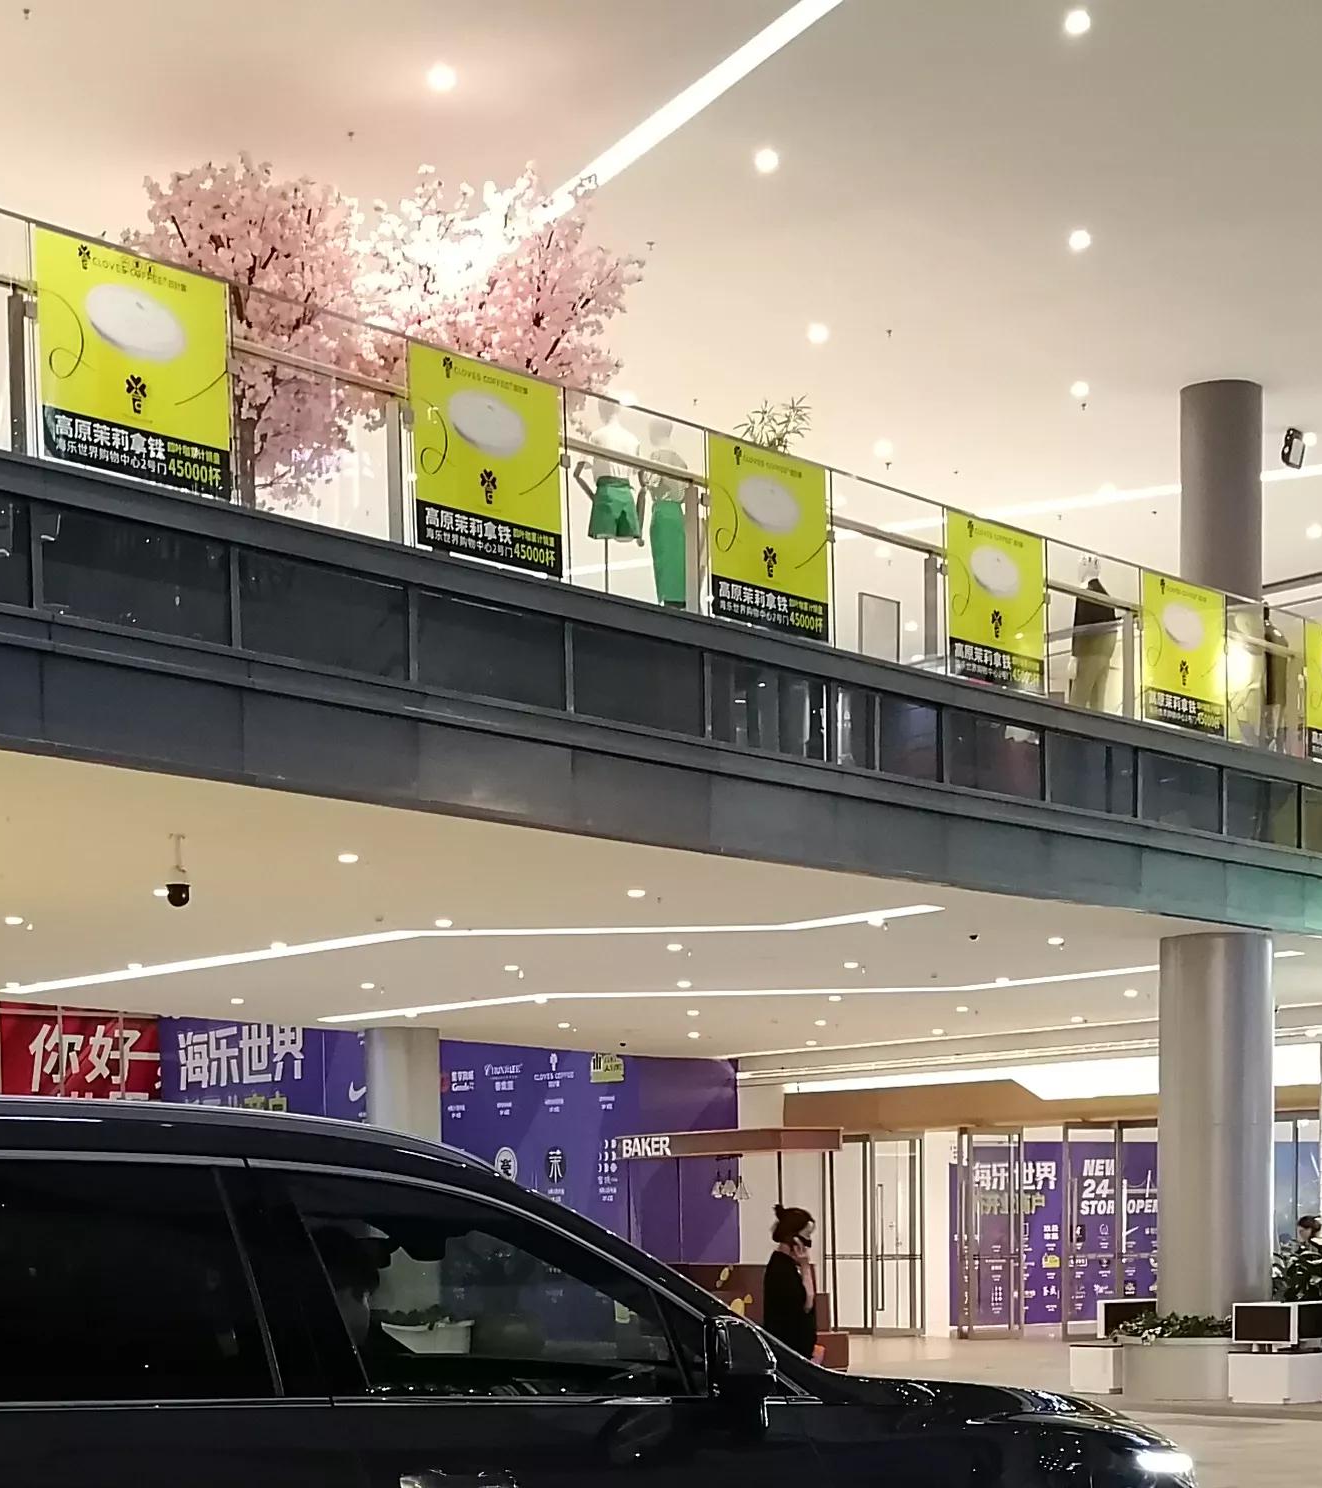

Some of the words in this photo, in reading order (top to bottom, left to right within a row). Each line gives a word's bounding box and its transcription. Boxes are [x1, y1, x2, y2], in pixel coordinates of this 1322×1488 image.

[54, 414, 166, 461] 高原茉莉拿铁
[167, 457, 223, 488] 45000杯
[424, 506, 513, 545] 高原茉莉拿铁
[513, 542, 557, 568] 45000杯
[29, 1023, 160, 1093] 你好
[179, 1023, 306, 1092] 海乐世界
[621, 1136, 672, 1159] BAKER
[1081, 1178, 1109, 1199] 24
